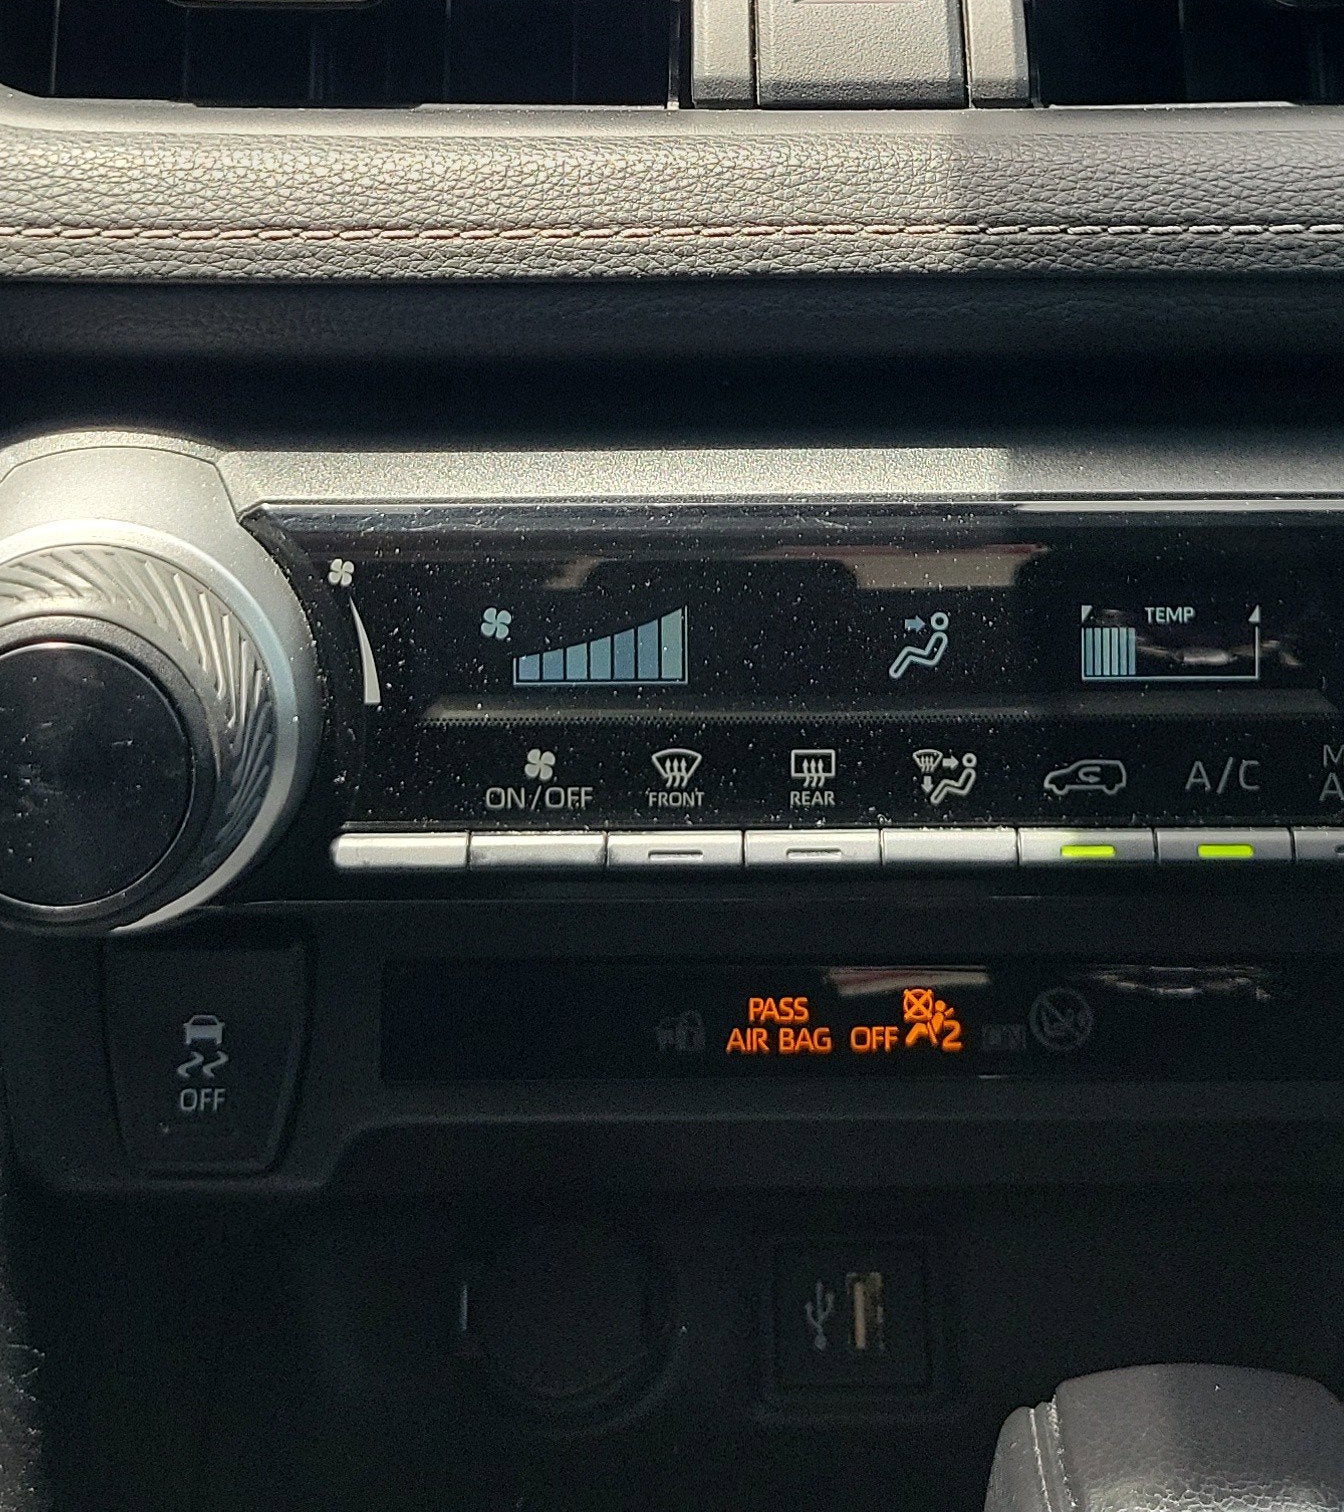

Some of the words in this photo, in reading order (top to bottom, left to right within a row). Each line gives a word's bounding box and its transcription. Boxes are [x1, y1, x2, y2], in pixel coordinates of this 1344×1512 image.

[1144, 606, 1195, 624] TEMP
[1185, 759, 1260, 793] A/C
[648, 791, 706, 808] FRONT
[789, 790, 836, 807] REAR
[748, 997, 810, 1023] PASS
[726, 1027, 770, 1054] AIR
[778, 1027, 832, 1054] BAG
[850, 1026, 900, 1054] OFF
[179, 1088, 227, 1111] OFF
